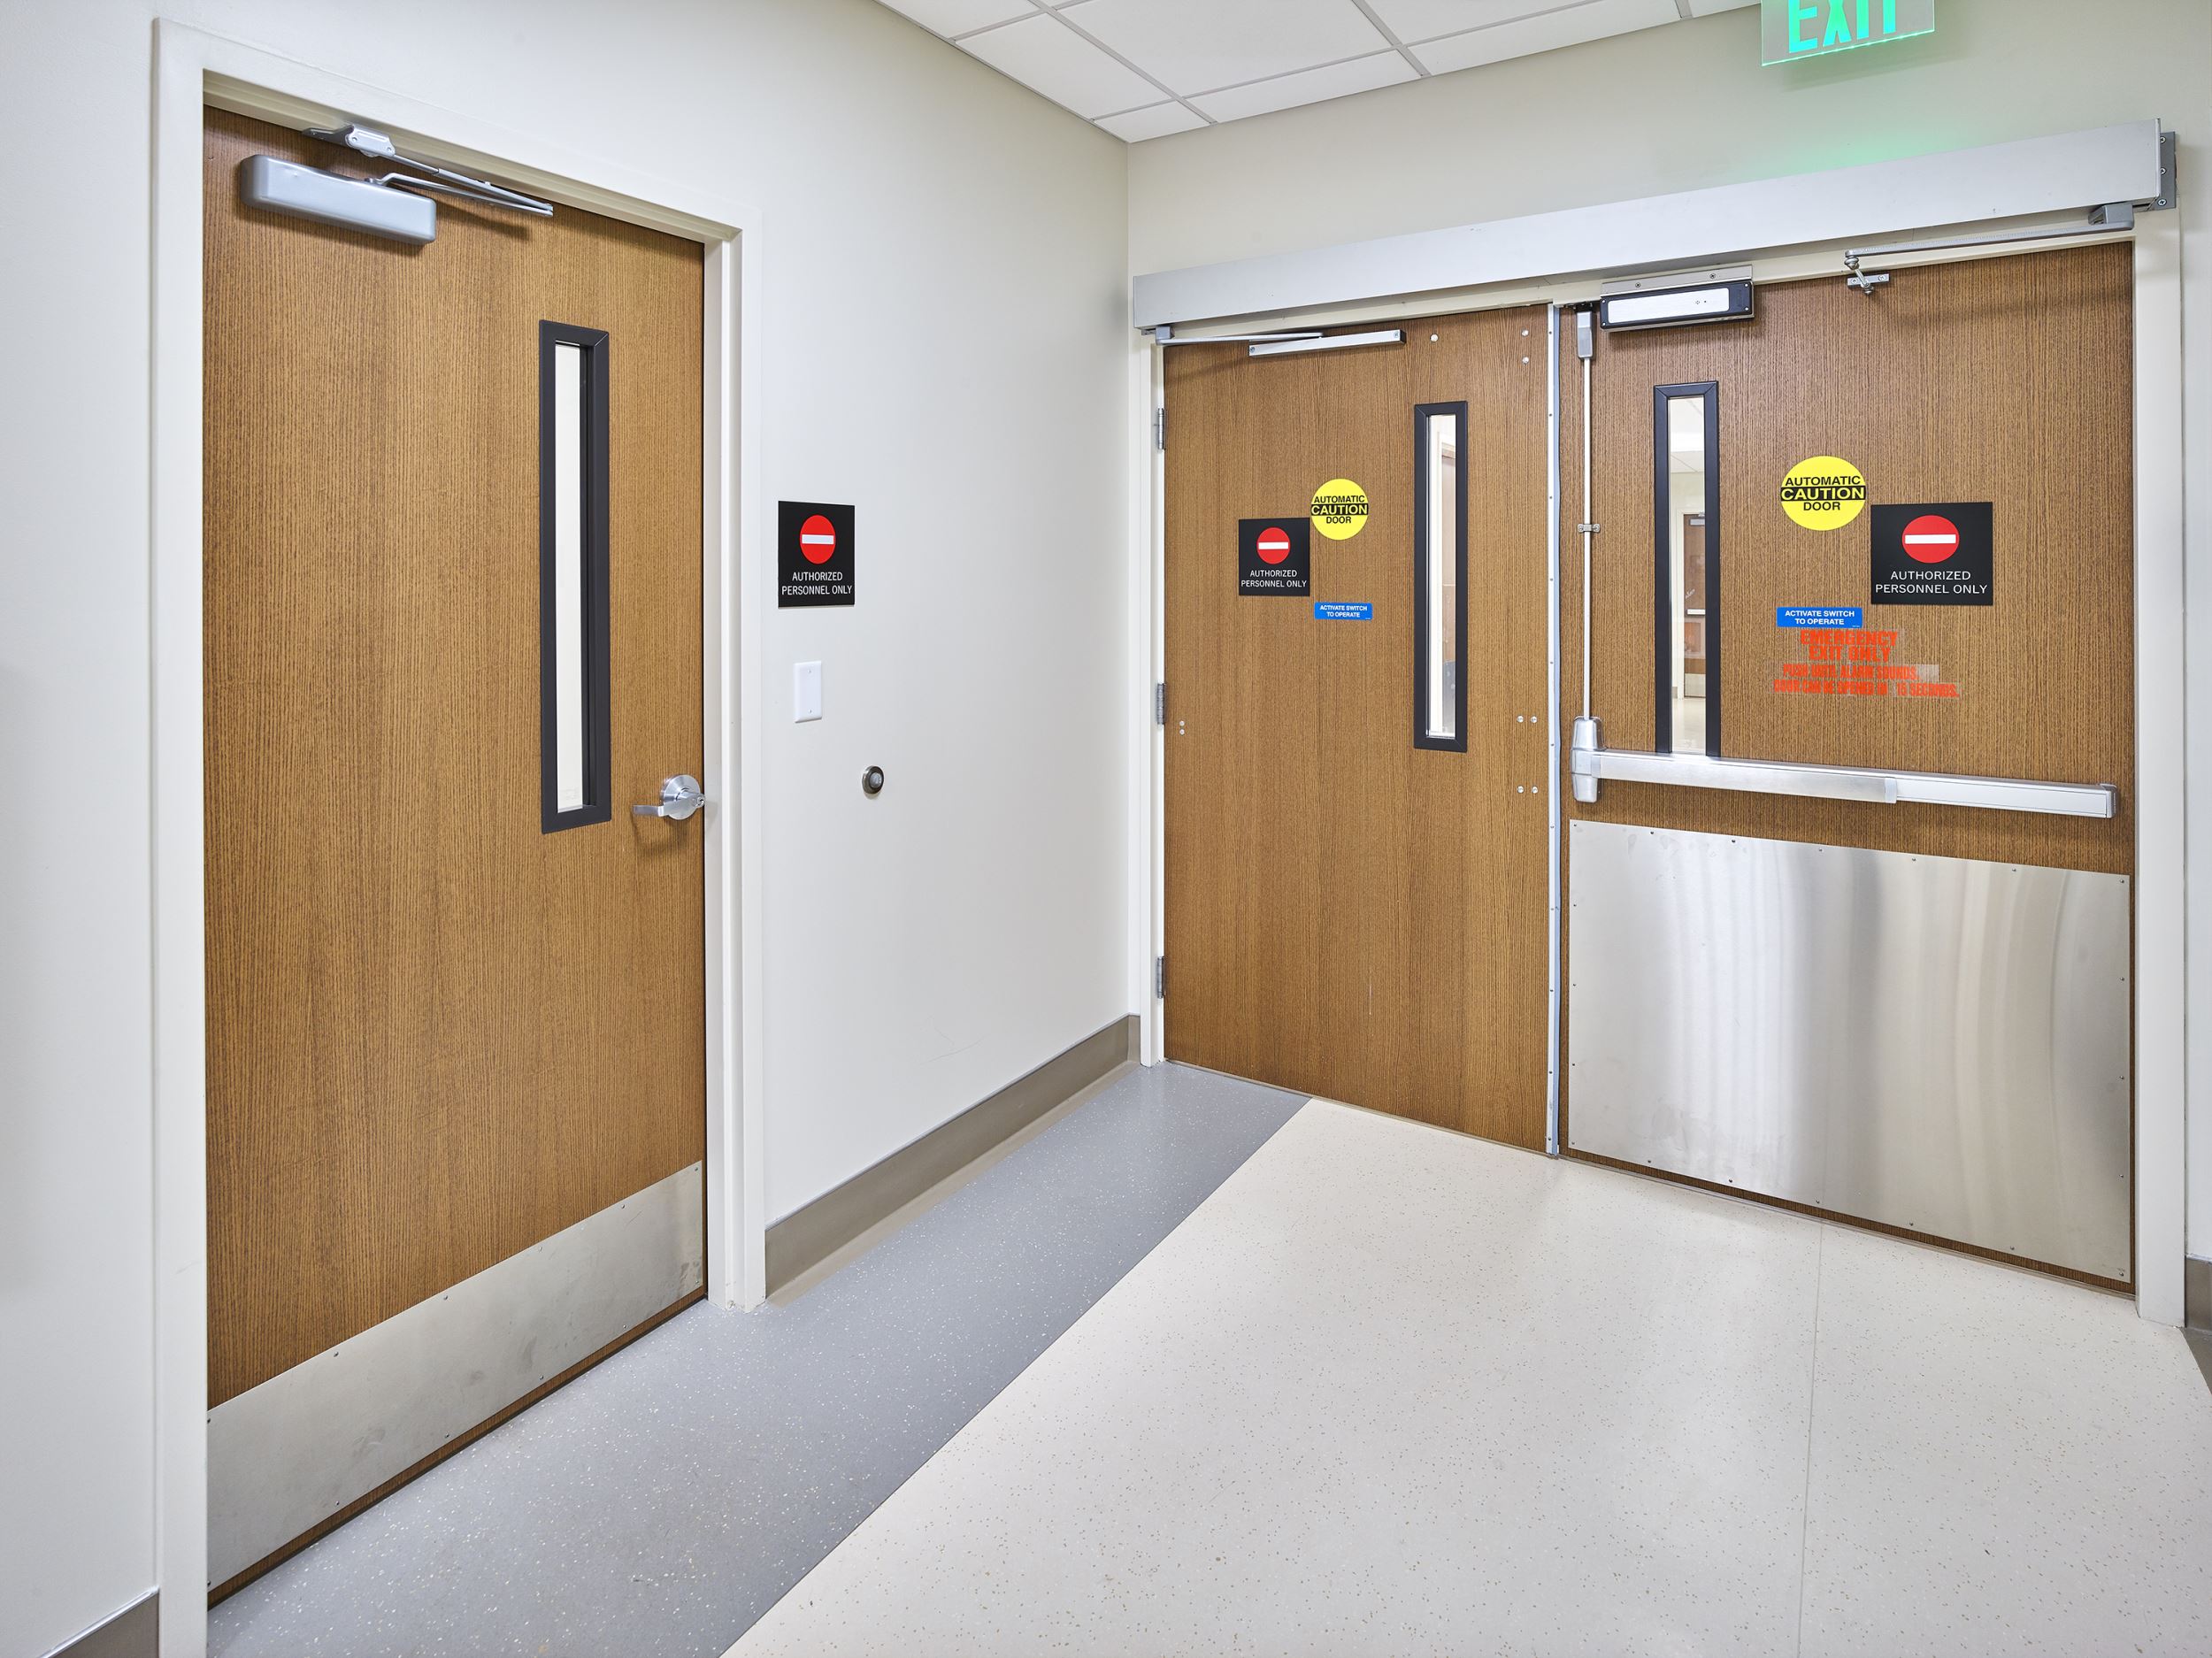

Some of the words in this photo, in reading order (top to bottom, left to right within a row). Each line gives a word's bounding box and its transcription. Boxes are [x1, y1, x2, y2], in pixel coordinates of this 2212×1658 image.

[1785, 475, 1861, 486] AUTOMATIC
[1314, 495, 1364, 503] AUTOMATIC
[1781, 487, 1864, 501] CAUTION
[1311, 504, 1368, 515] CAUTION
[1803, 501, 1840, 511] DOOR
[792, 572, 843, 581] AUTHORIZED
[1249, 569, 1297, 578] AUTHORIZED
[1890, 571, 1971, 580] AUTHORIZED
[781, 585, 830, 595] PERSONNEL
[832, 585, 852, 595] ONLY
[1875, 584, 1949, 594] PERSONNEL
[1953, 584, 1987, 594] ONLY
[1801, 629, 1898, 646] EMERGENCY
[1809, 645, 1841, 661] EXIT
[1848, 646, 1891, 663] ONLY
[1783, 664, 1809, 677] PUSH
[1840, 664, 1874, 679] ALARM
[1774, 679, 1800, 693] DOOR
[1802, 679, 1821, 694] CAN
[1823, 679, 1835, 695] BE
[1837, 680, 1874, 695] OPENED
[1877, 681, 1887, 695] IN
[1897, 682, 1907, 696] 15
